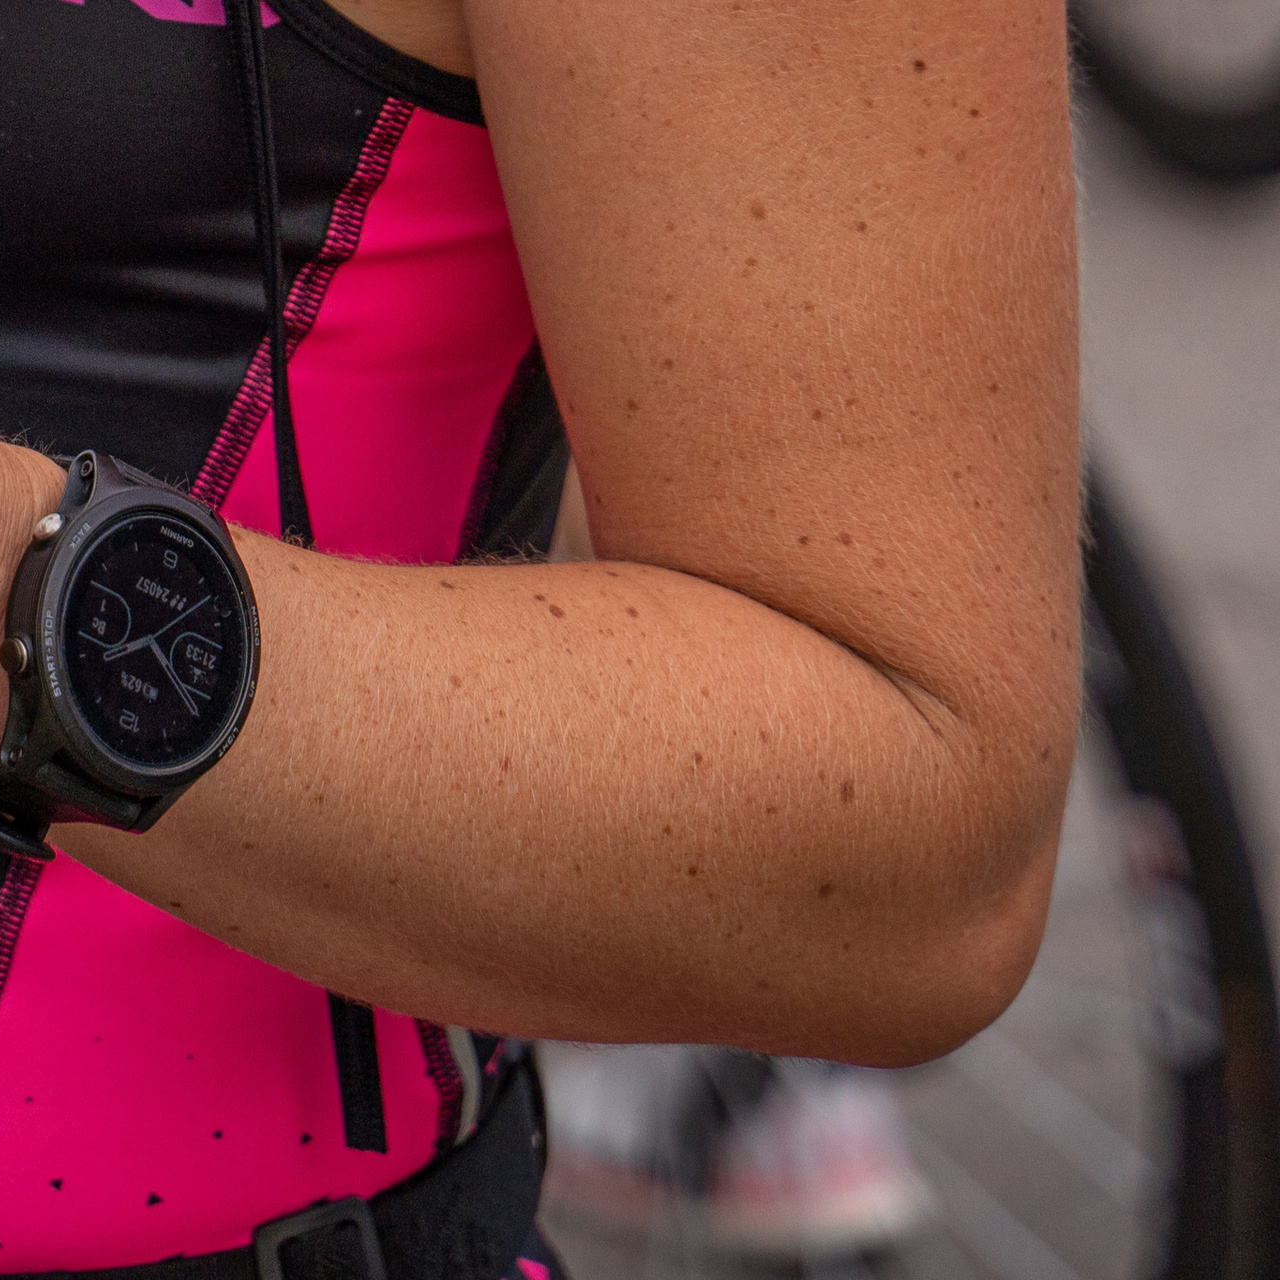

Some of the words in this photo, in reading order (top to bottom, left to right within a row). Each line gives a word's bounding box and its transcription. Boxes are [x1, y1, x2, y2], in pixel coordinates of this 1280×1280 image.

[70, 522, 91, 550] BACK
[159, 524, 195, 549] GARMIN
[136, 576, 171, 604] 24057
[251, 605, 261, 646] DOWN
[185, 643, 218, 670] 21:33
[121, 670, 143, 693] 62%
[119, 708, 141, 734] 12
[218, 726, 240, 758] LIGHT
